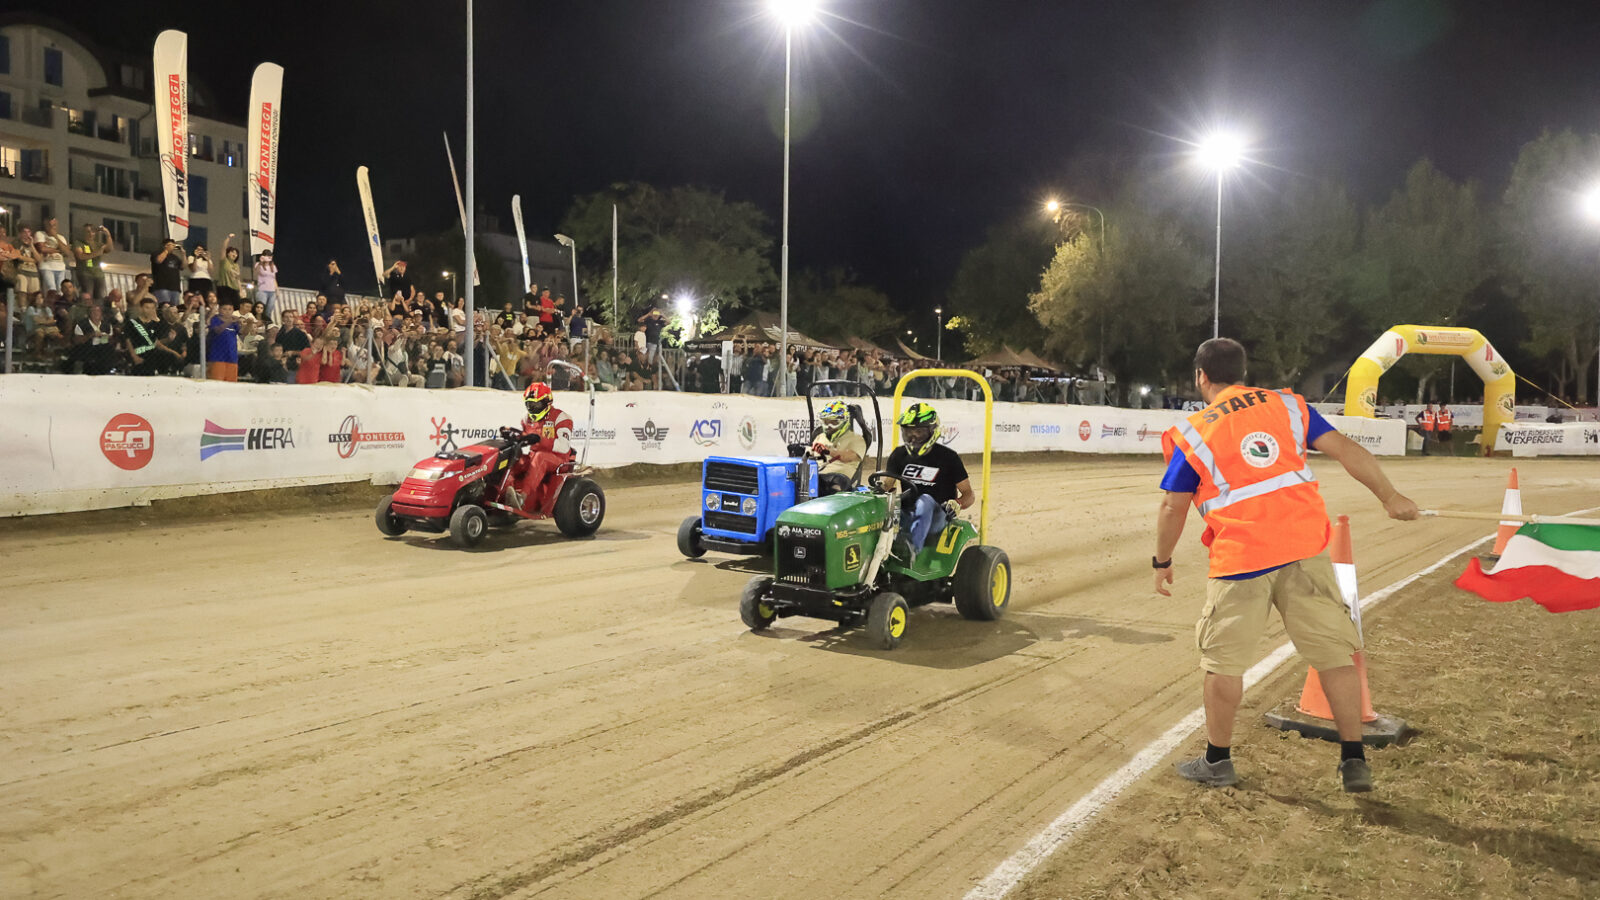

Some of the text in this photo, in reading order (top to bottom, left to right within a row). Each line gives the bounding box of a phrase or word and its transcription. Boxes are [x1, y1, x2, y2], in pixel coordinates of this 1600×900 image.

[169, 75, 181, 157] PONTEGGI
[260, 103, 272, 178] PONTEGGI
[177, 174, 185, 207] FAST
[261, 192, 270, 223] FAST
[1202, 390, 1268, 424] STAFF
[591, 427, 616, 440] Ponteggi
[689, 419, 721, 438] ACSI
[787, 419, 800, 429] THE
[995, 422, 1021, 433] misano
[1030, 423, 1061, 434] misano
[247, 427, 295, 450] HERA
[329, 432, 404, 443] FAST PONTEGGI
[1512, 435, 1564, 444] EXPERIENCE
